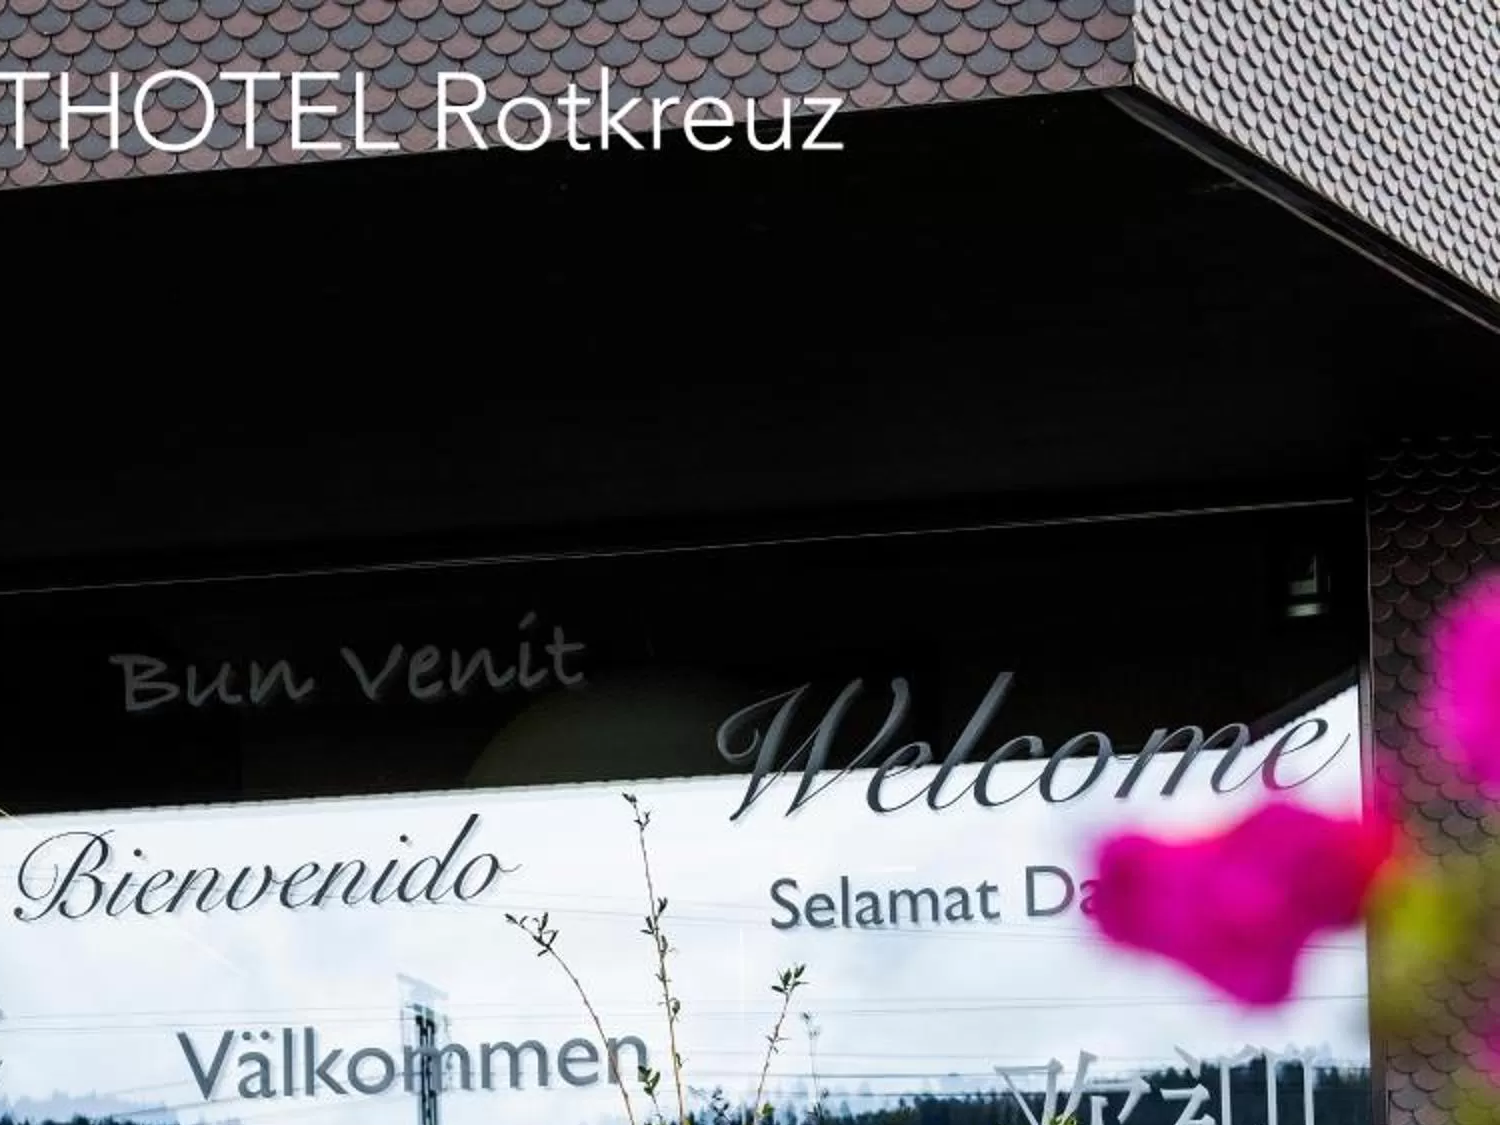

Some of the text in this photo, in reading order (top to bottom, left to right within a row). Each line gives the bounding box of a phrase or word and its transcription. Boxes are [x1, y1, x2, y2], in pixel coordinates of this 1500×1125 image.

[109, 652, 315, 712] Bun
[716, 671, 1350, 822] Welcome
[14, 813, 522, 923] Bienvenido
[770, 872, 1000, 930] Selamat
[176, 1026, 648, 1100] Välkommen
